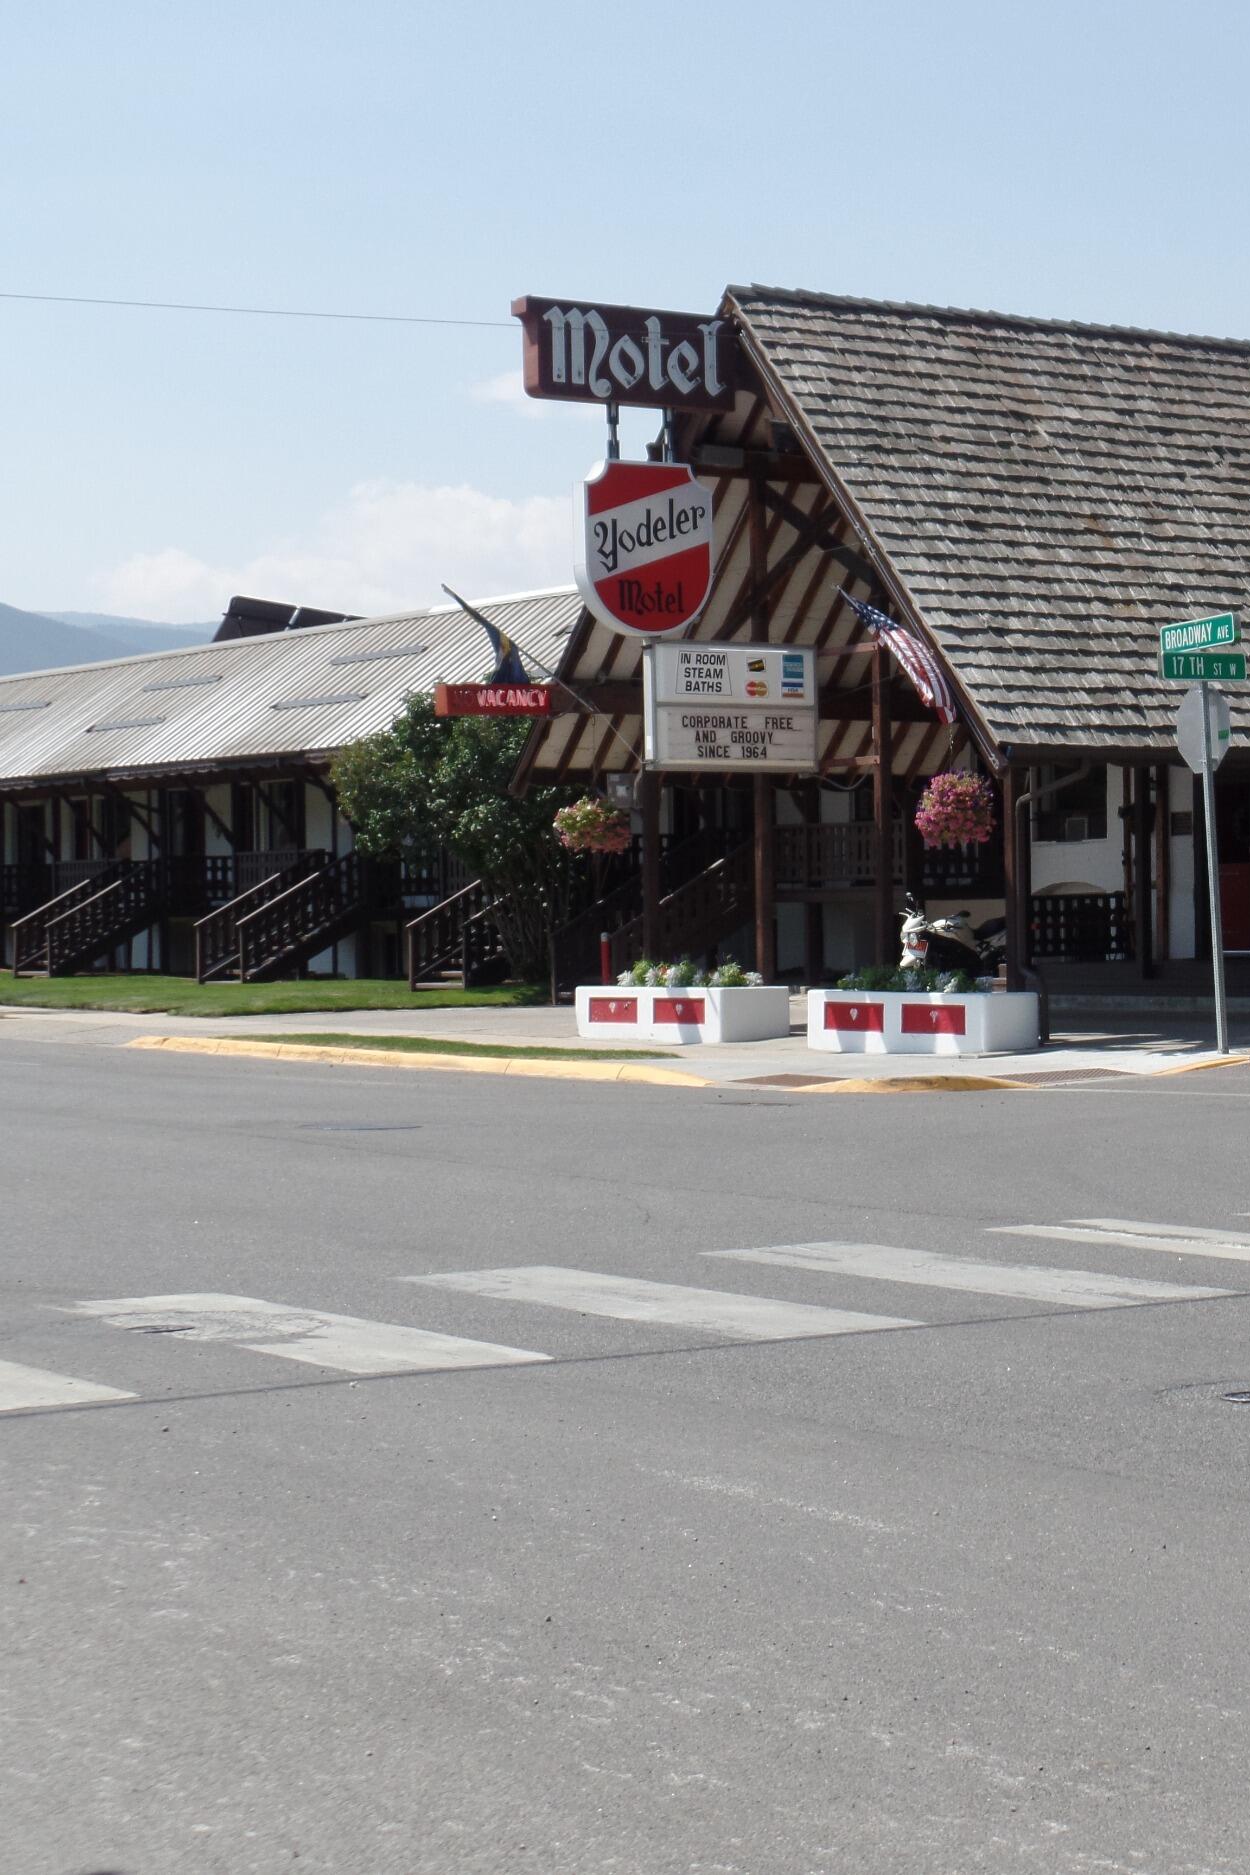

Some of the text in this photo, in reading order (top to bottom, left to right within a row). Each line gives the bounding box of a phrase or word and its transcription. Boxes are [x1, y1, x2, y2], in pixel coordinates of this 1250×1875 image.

[543, 306, 726, 397] Motel
[594, 498, 705, 572] Yodeler
[618, 579, 684, 614] Motel
[1165, 622, 1229, 650] BROADWAY AVE
[680, 653, 726, 665] IN ROOM
[684, 667, 723, 679] STEAM
[1213, 662, 1222, 676] ST
[1229, 663, 1237, 676] W
[685, 681, 722, 692] BATHS
[477, 689, 547, 707] VACANCY
[682, 715, 793, 729] CORPORATE FREE
[695, 730, 773, 744] AND GROOVY
[697, 746, 767, 758] SINCE 1964
